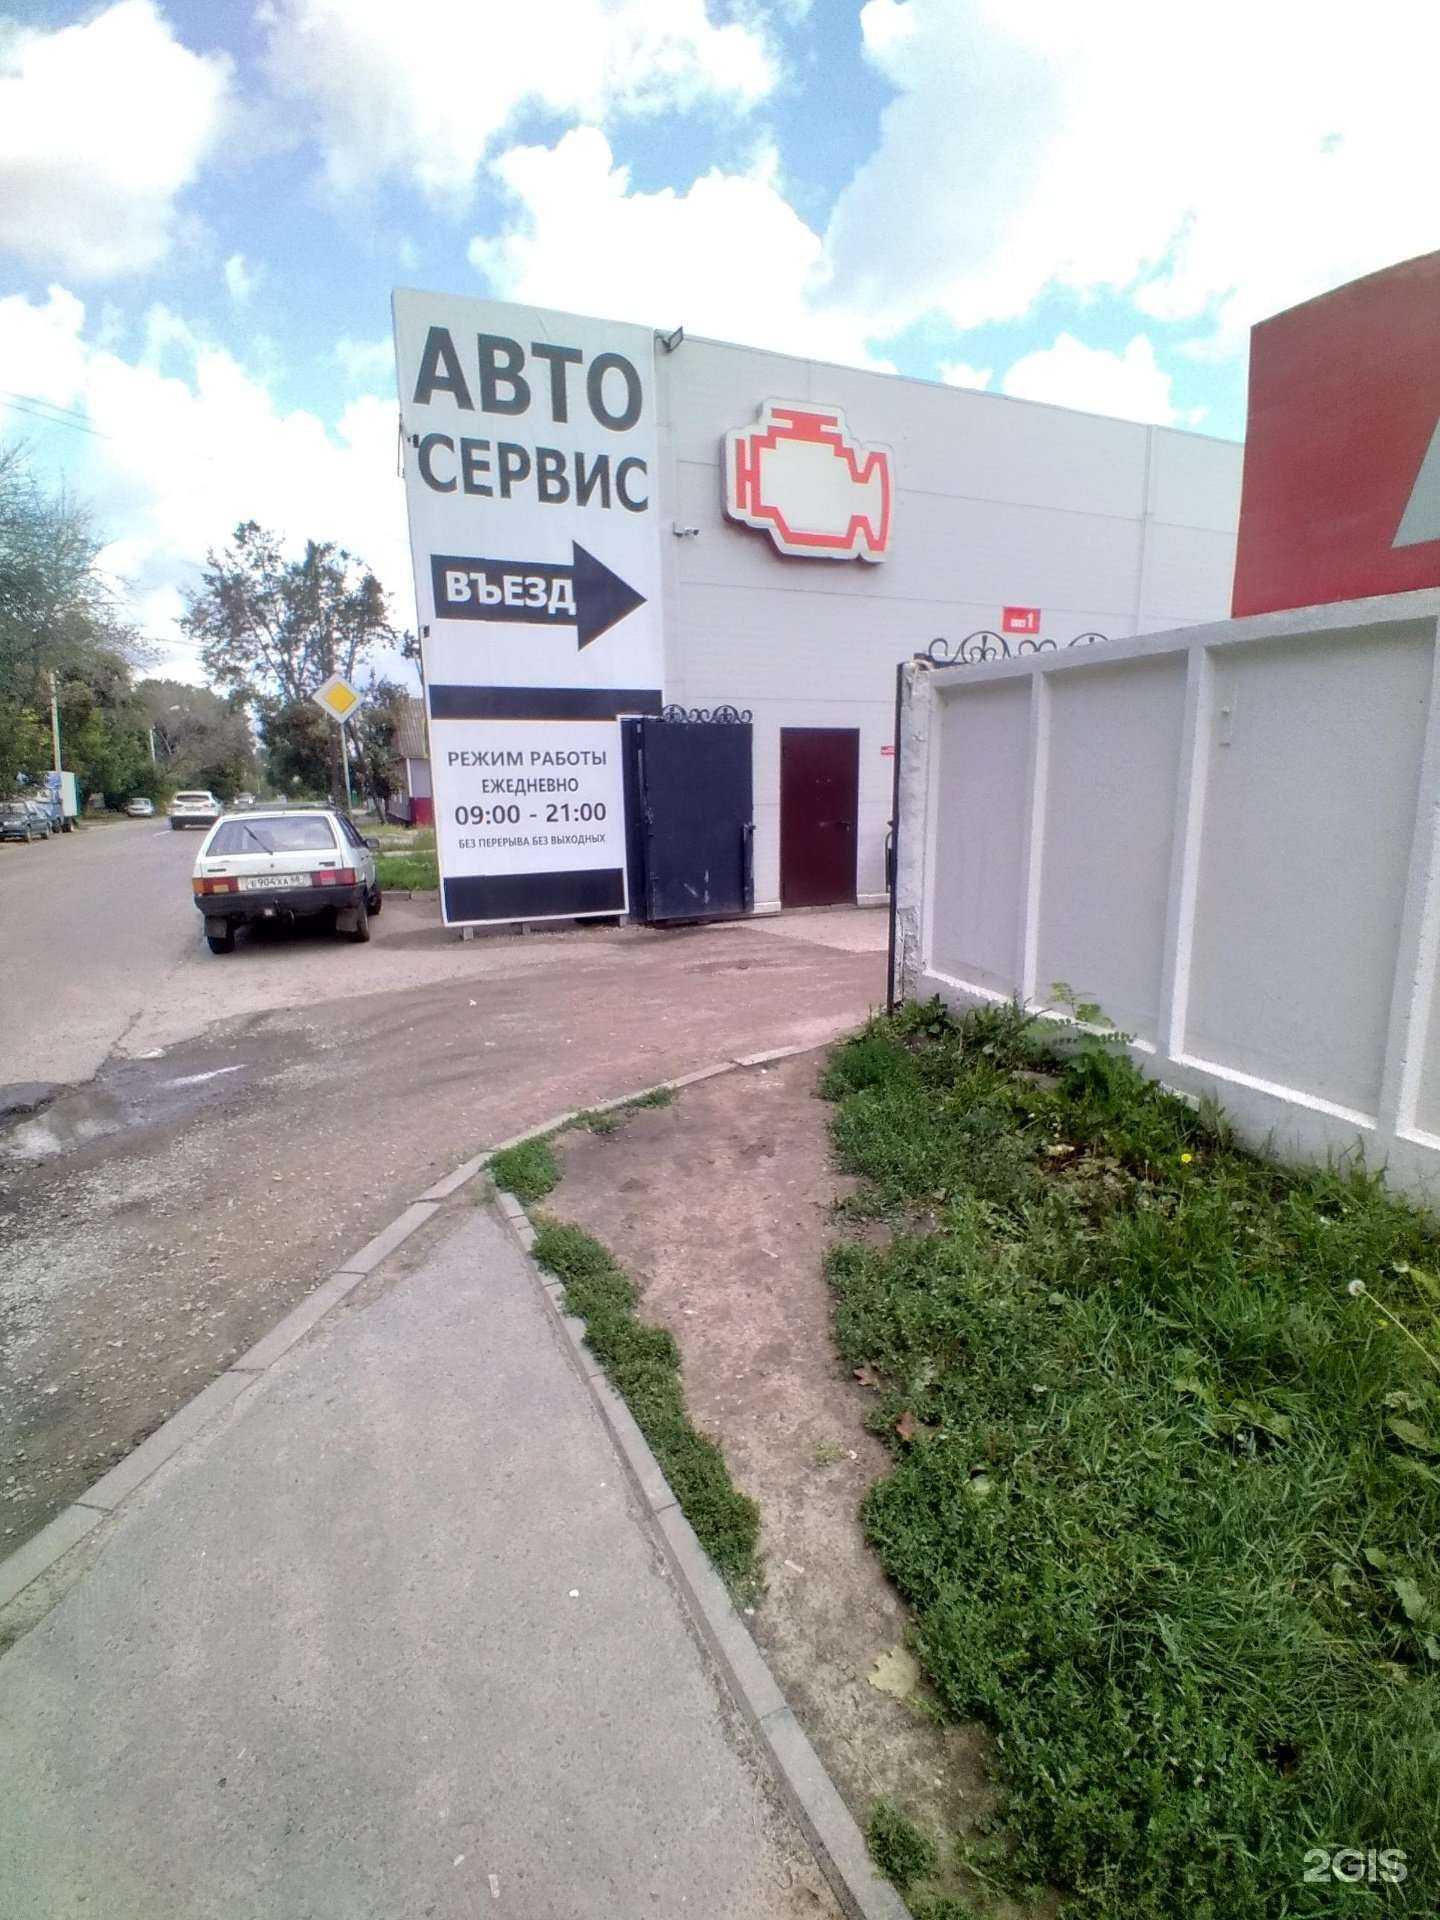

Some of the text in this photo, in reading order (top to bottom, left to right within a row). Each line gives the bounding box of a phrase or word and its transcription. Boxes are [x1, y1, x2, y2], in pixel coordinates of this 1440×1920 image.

[413, 326, 642, 432] АВТО
[417, 432, 649, 513] СЕРВИС
[445, 570, 577, 616] ВЪЕЗД
[448, 751, 607, 767] РЕЖИМ РАБОТЫ
[482, 777, 579, 796] ЕЖЕДНЕВНО
[454, 804, 521, 825] 09:00
[545, 802, 607, 822] 21:00
[458, 833, 606, 849] БЕЗ ПЕРЕРЫВА БЕЗ ВЫХОДНЫХ
